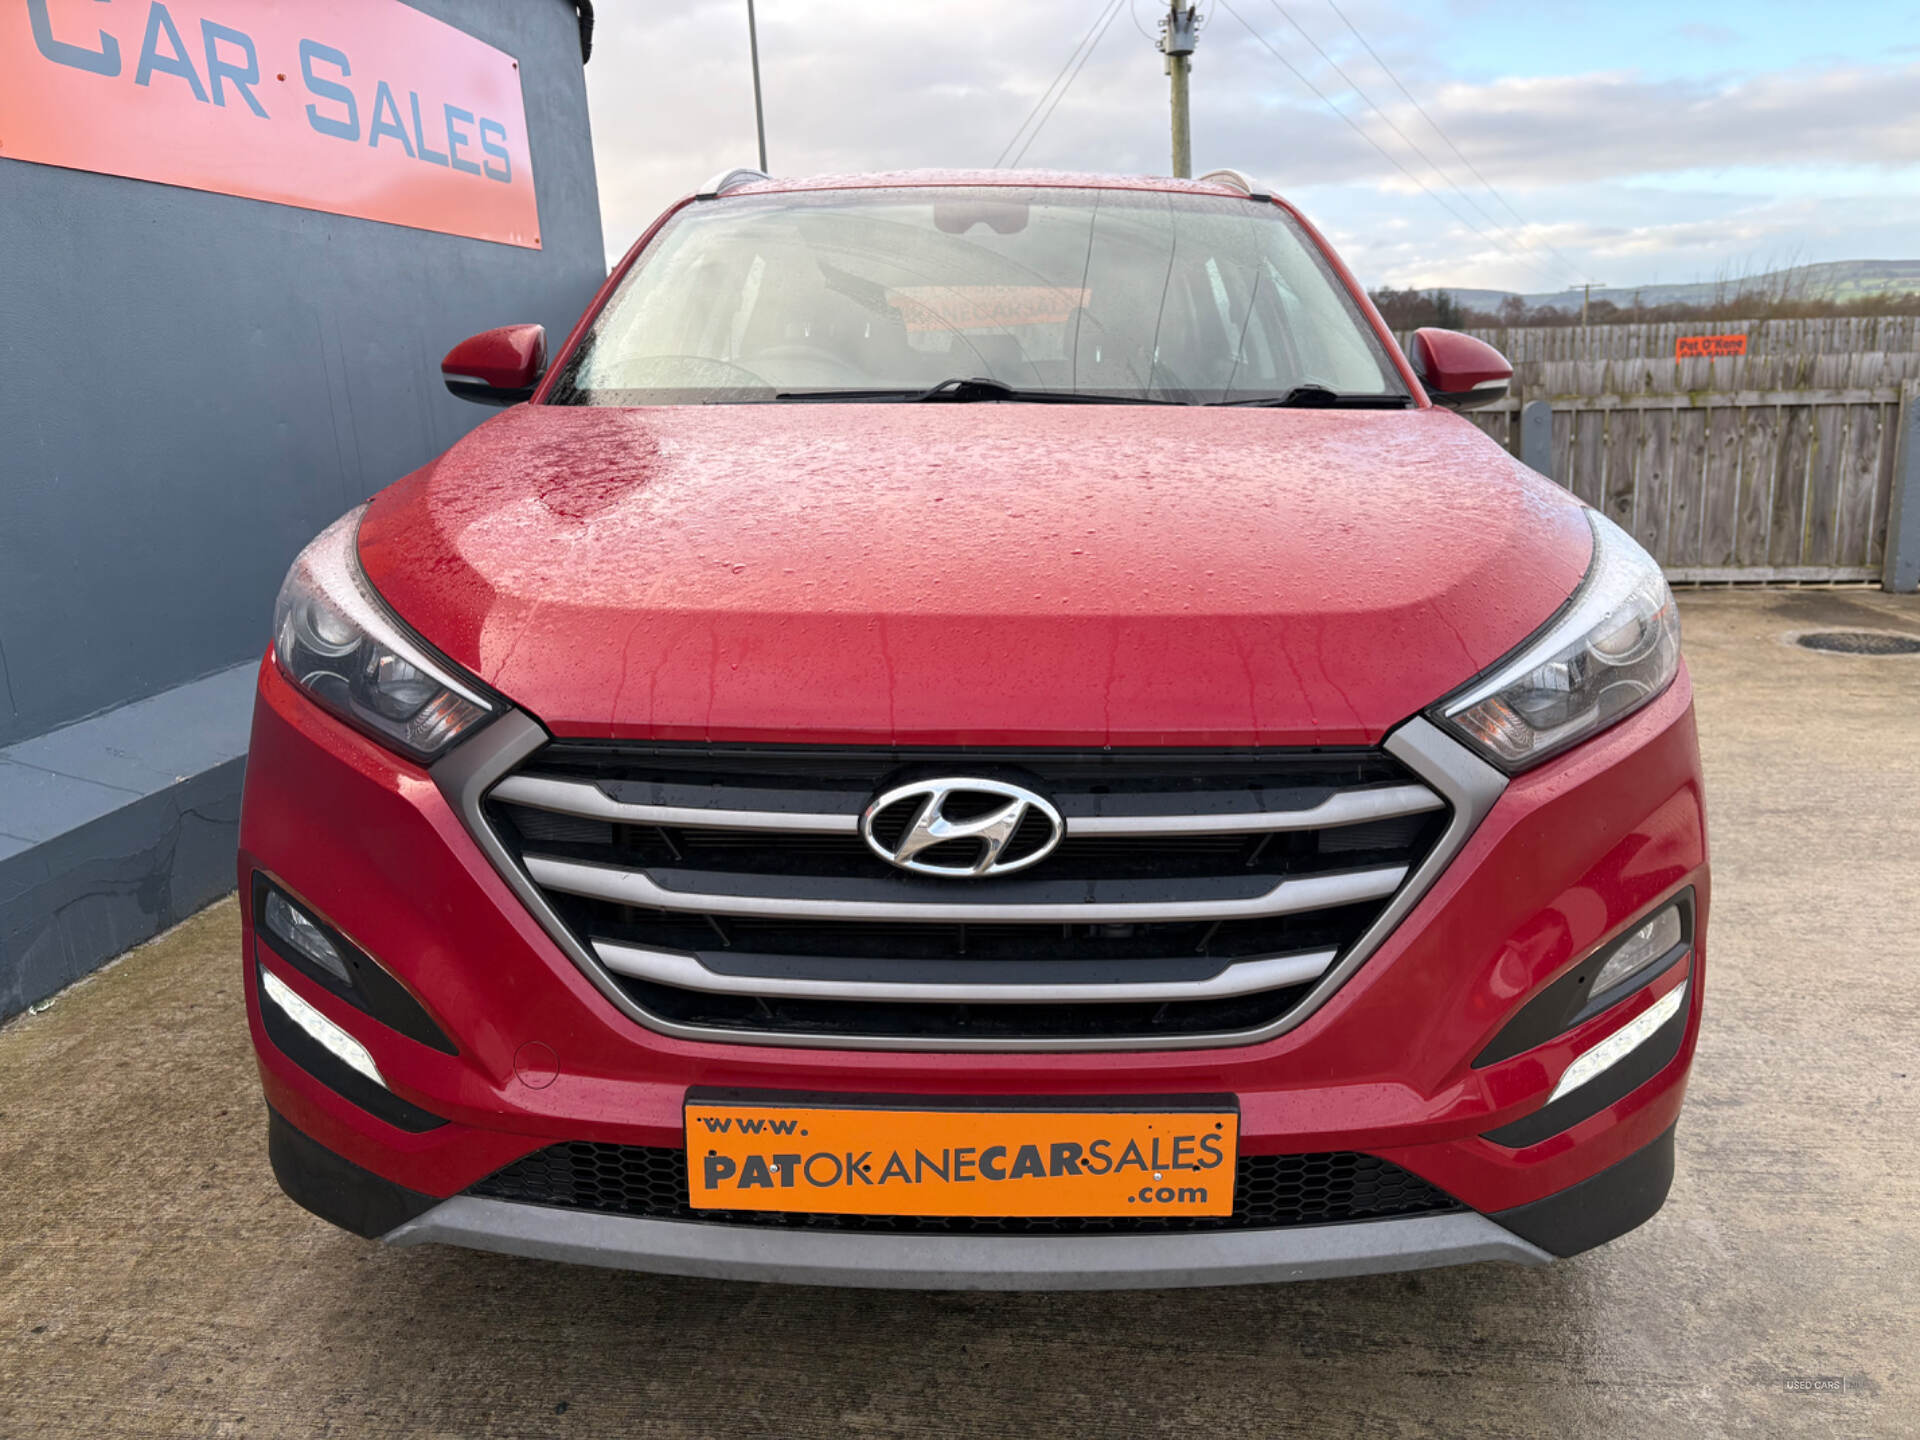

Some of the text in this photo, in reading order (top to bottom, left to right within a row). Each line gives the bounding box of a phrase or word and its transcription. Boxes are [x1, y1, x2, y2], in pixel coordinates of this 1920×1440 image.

[27, 0, 512, 183] CAR SALES
[703, 1118, 808, 1136] www.
[1128, 1187, 1207, 1203] .com
